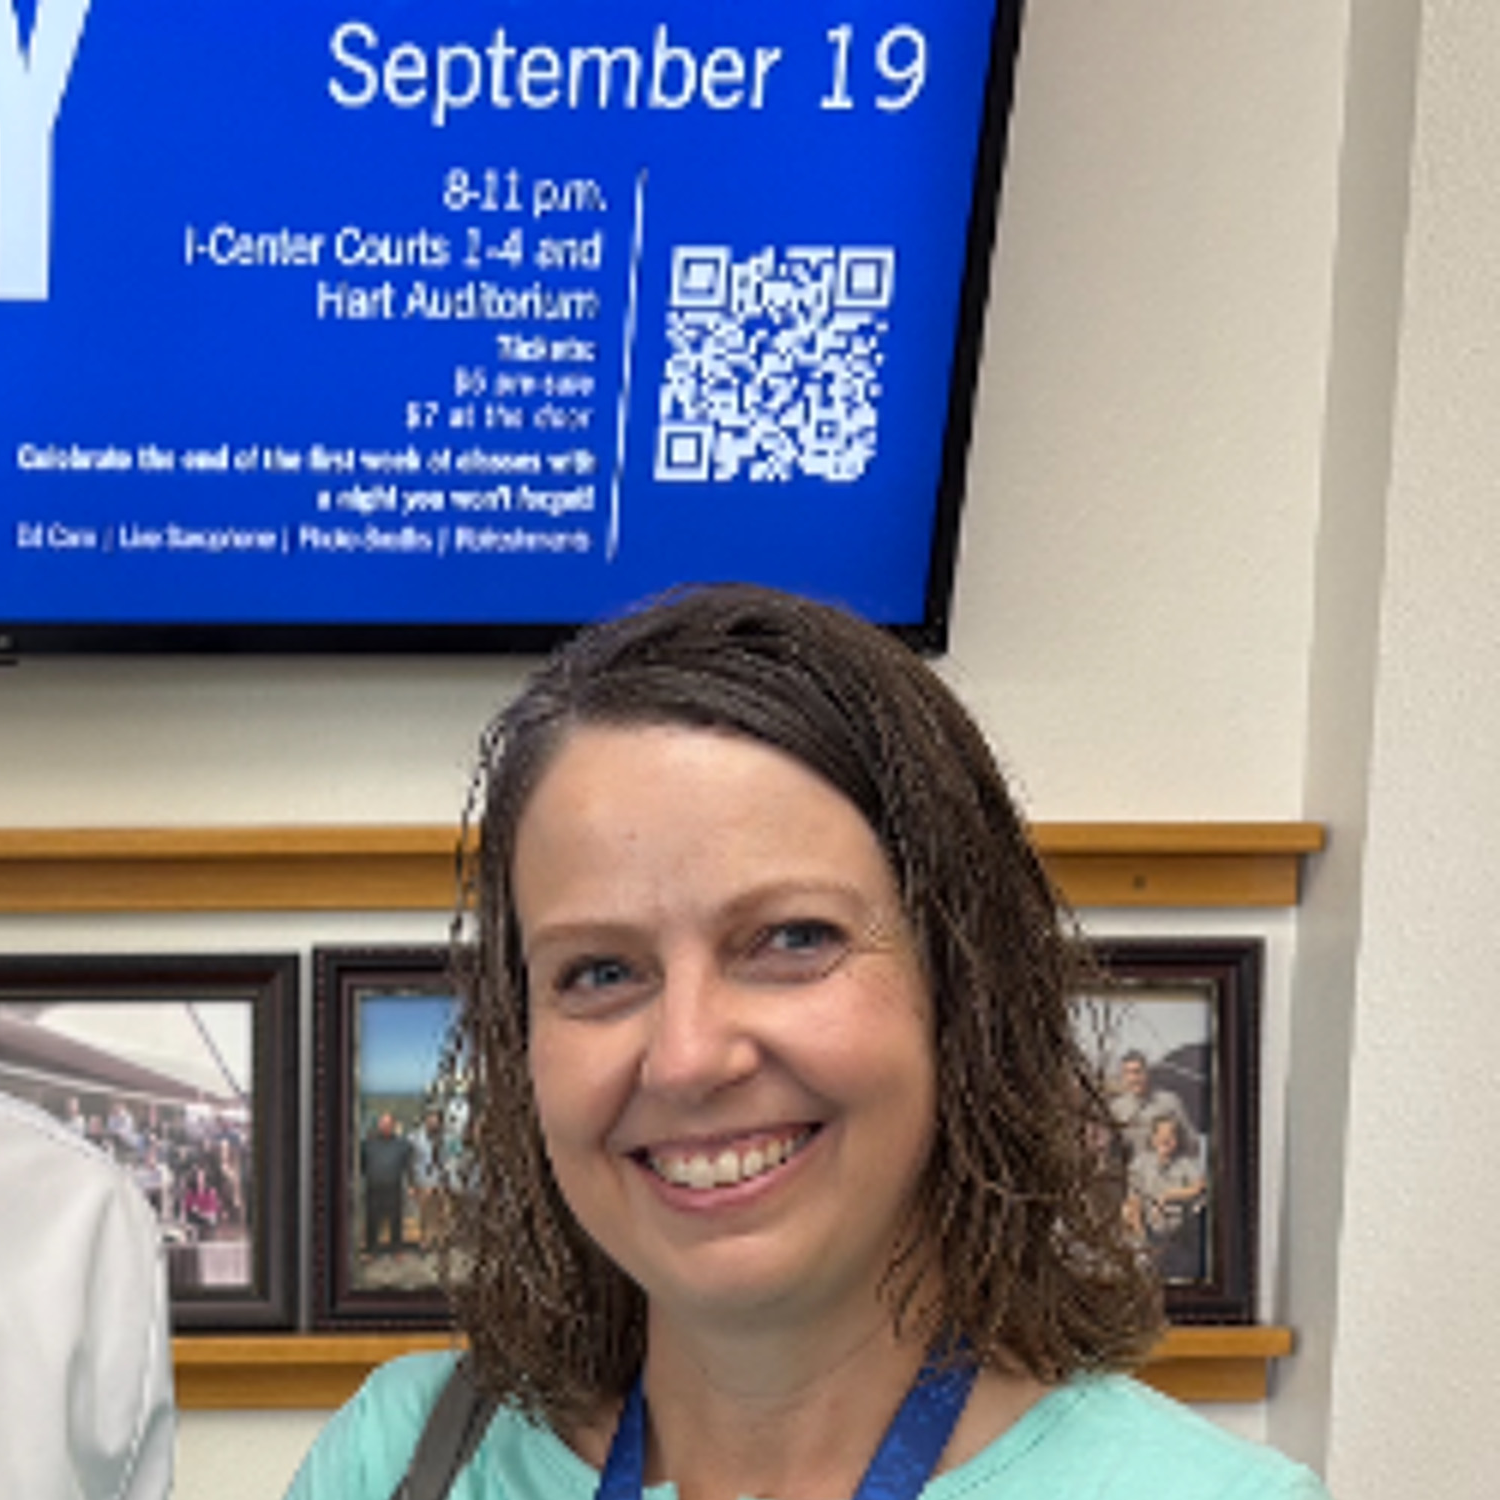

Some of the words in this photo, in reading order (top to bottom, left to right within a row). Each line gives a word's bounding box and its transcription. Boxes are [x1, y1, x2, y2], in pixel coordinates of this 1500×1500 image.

[328, 21, 783, 128] September
[819, 23, 927, 112] 19
[442, 167, 523, 211] 8-11
[184, 223, 325, 266] I-Center
[334, 225, 451, 268] Courts
[463, 227, 524, 269] 1-4
[534, 231, 603, 270] and
[316, 280, 395, 320] Hart
[402, 280, 599, 321] Auditorium
